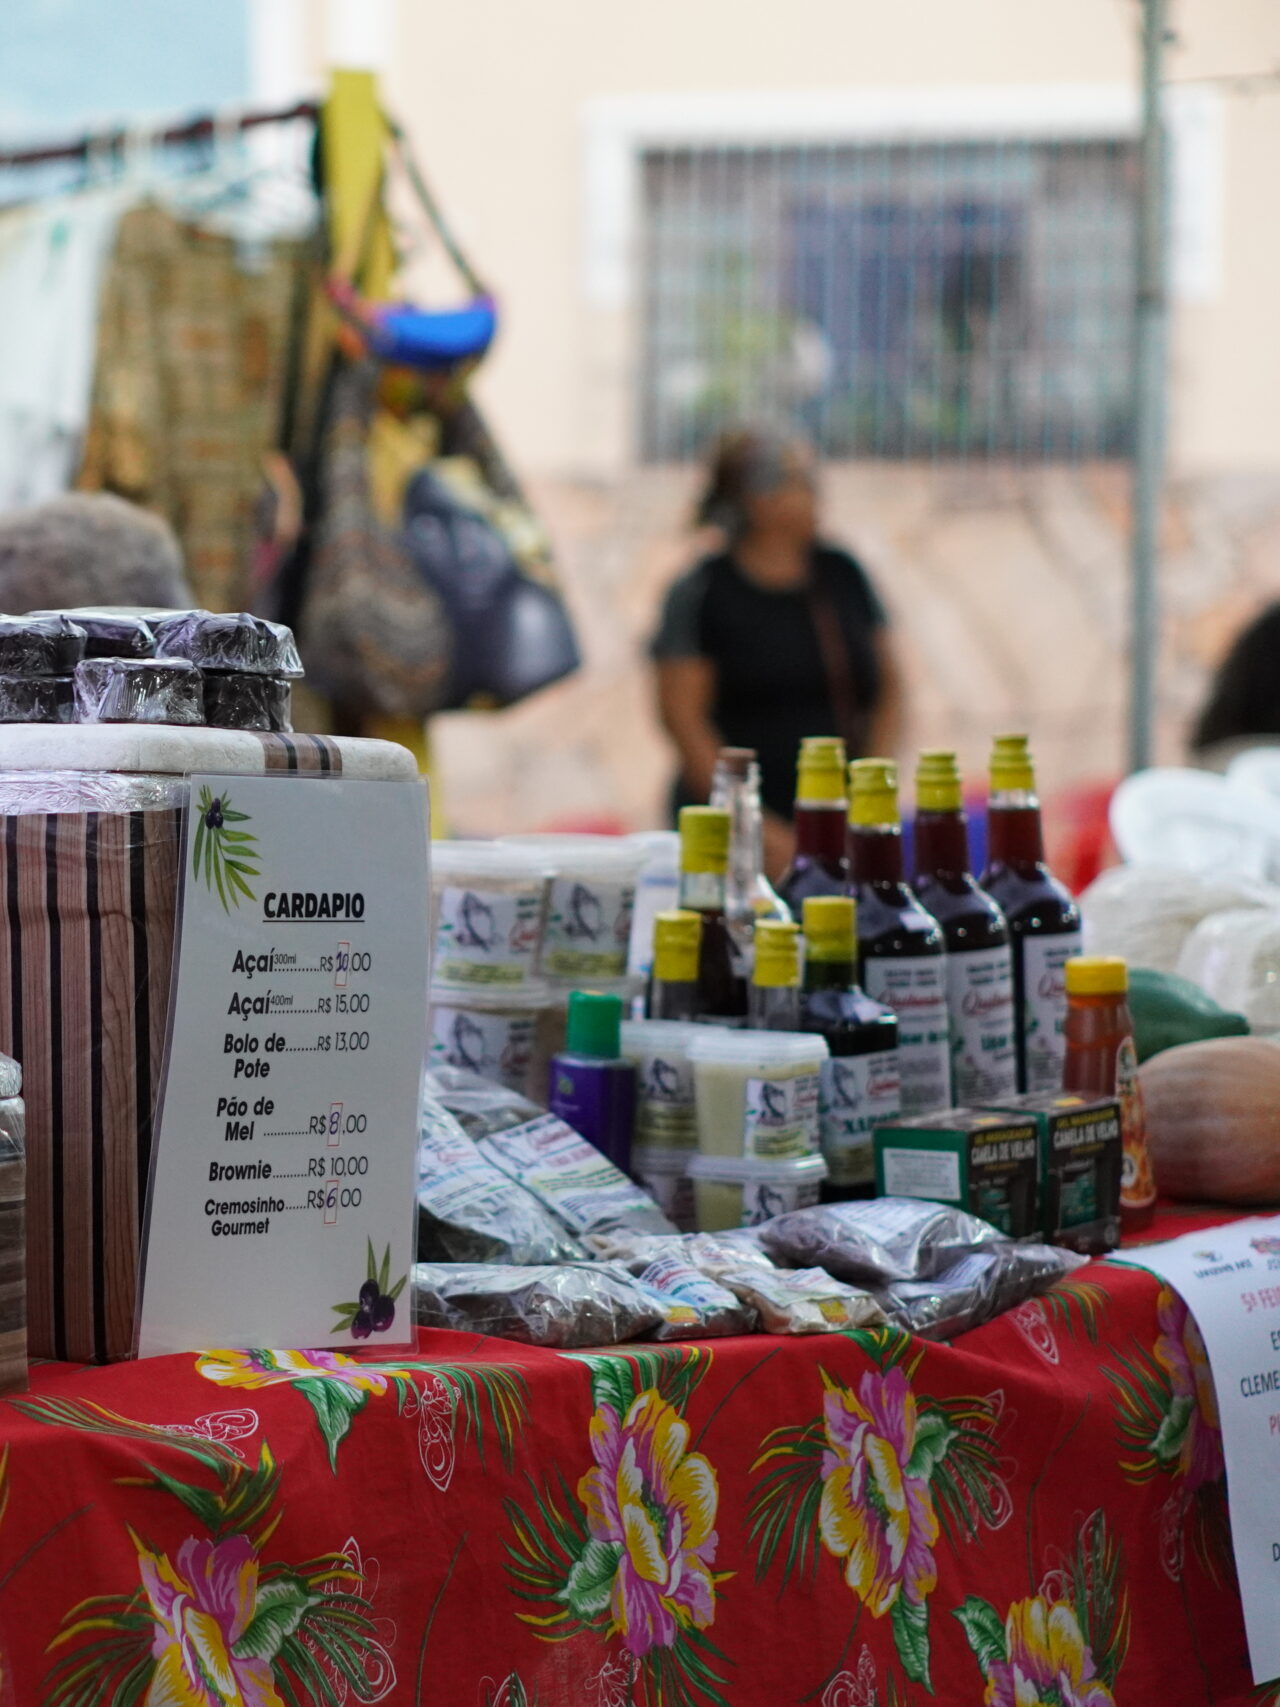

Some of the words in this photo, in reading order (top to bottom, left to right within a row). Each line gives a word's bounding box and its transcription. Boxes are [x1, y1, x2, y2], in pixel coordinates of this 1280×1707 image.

[263, 892, 365, 919] CARDAPIO
[232, 947, 275, 979] Açaí
[274, 953, 297, 965] 300ml
[320, 956, 334, 972] R$
[227, 989, 272, 1021] Açaí
[270, 995, 294, 1006] 400ml
[317, 997, 332, 1014] R$
[335, 993, 370, 1015] 15,00
[223, 1033, 259, 1054] Bolo
[264, 1032, 286, 1053] de
[317, 1035, 331, 1052] R$
[335, 1031, 370, 1053] 13,00
[234, 1058, 271, 1079] Pote
[216, 1096, 248, 1117] Pão
[253, 1096, 275, 1116] de
[224, 1121, 255, 1141] Mel
[309, 1115, 327, 1135] R$
[208, 1160, 272, 1182] Brownie
[308, 1157, 326, 1177] R$
[331, 1156, 369, 1177] 10,00
[204, 1197, 285, 1216] Cremosinho
[307, 1190, 325, 1209] R$
[211, 1218, 270, 1236] Gourmet
